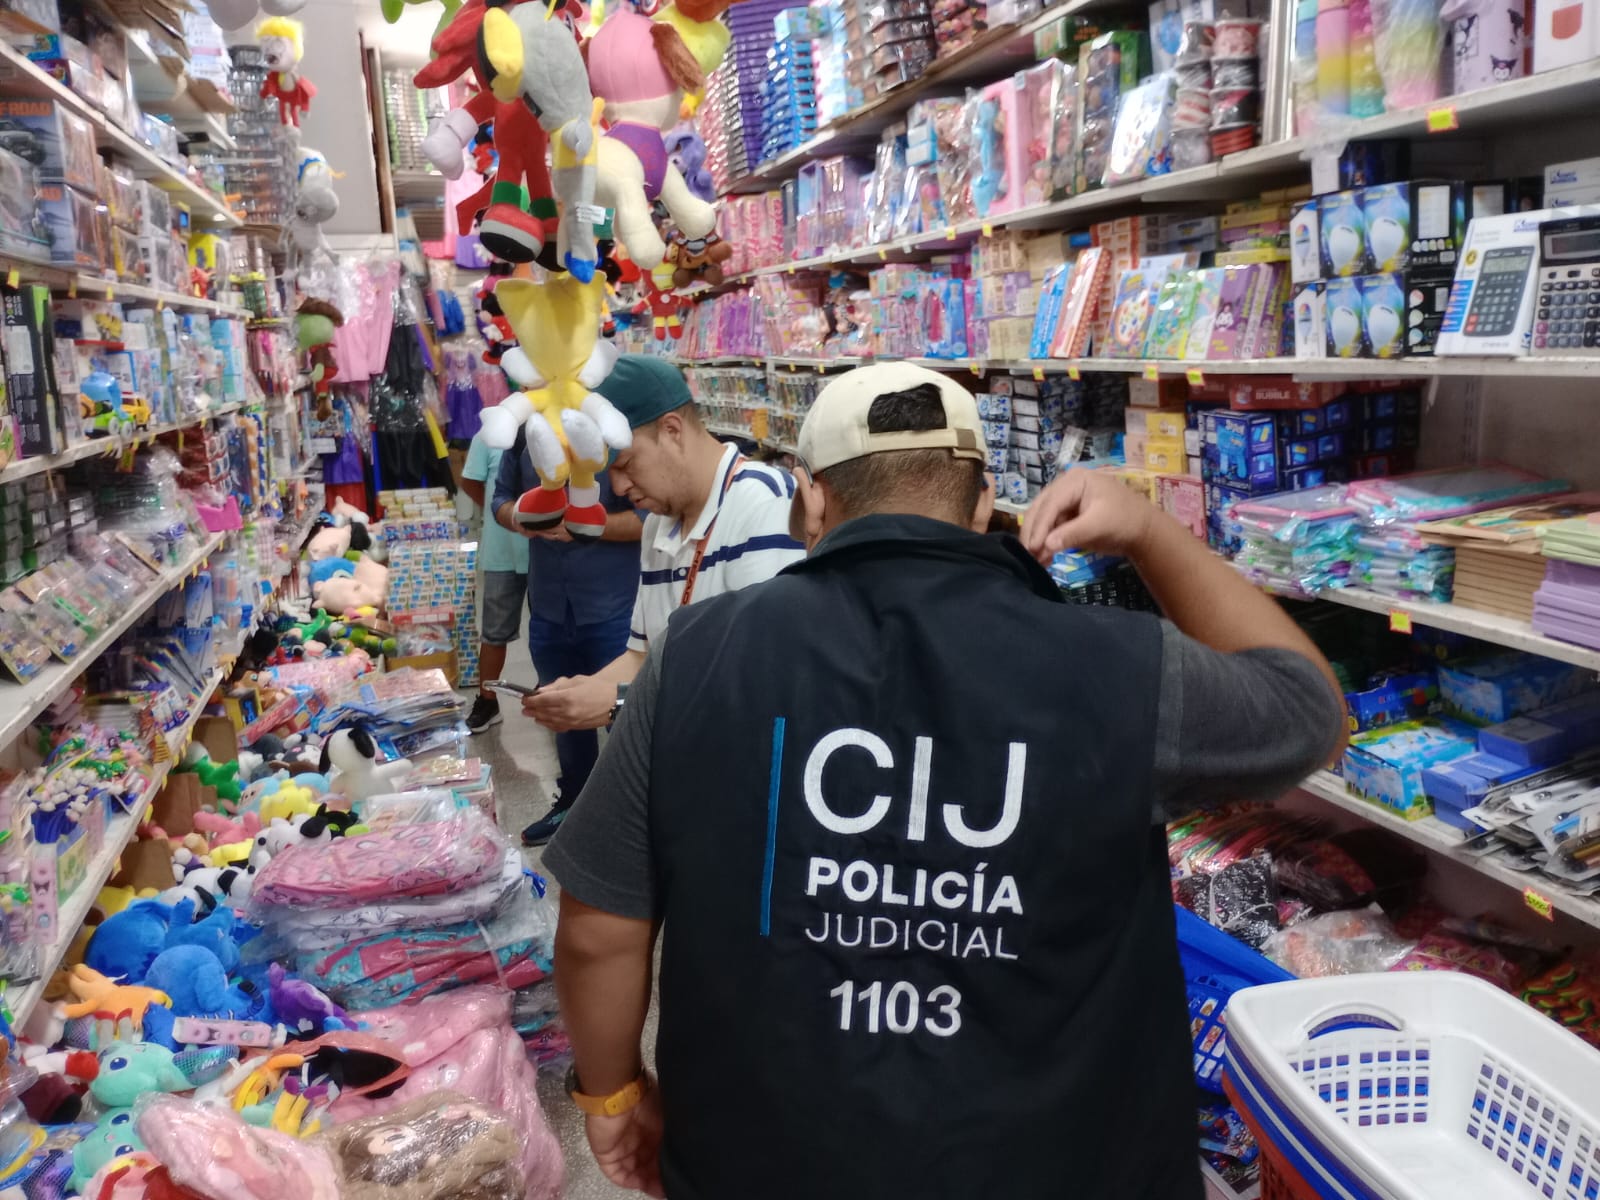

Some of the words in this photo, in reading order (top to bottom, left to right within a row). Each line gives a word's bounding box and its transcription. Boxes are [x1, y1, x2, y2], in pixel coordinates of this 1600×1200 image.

[803, 727, 1027, 848] CIJ
[804, 856, 1023, 915] POLICÍA
[804, 911, 1018, 960] JUDICIAL
[829, 979, 963, 1037] 1103
